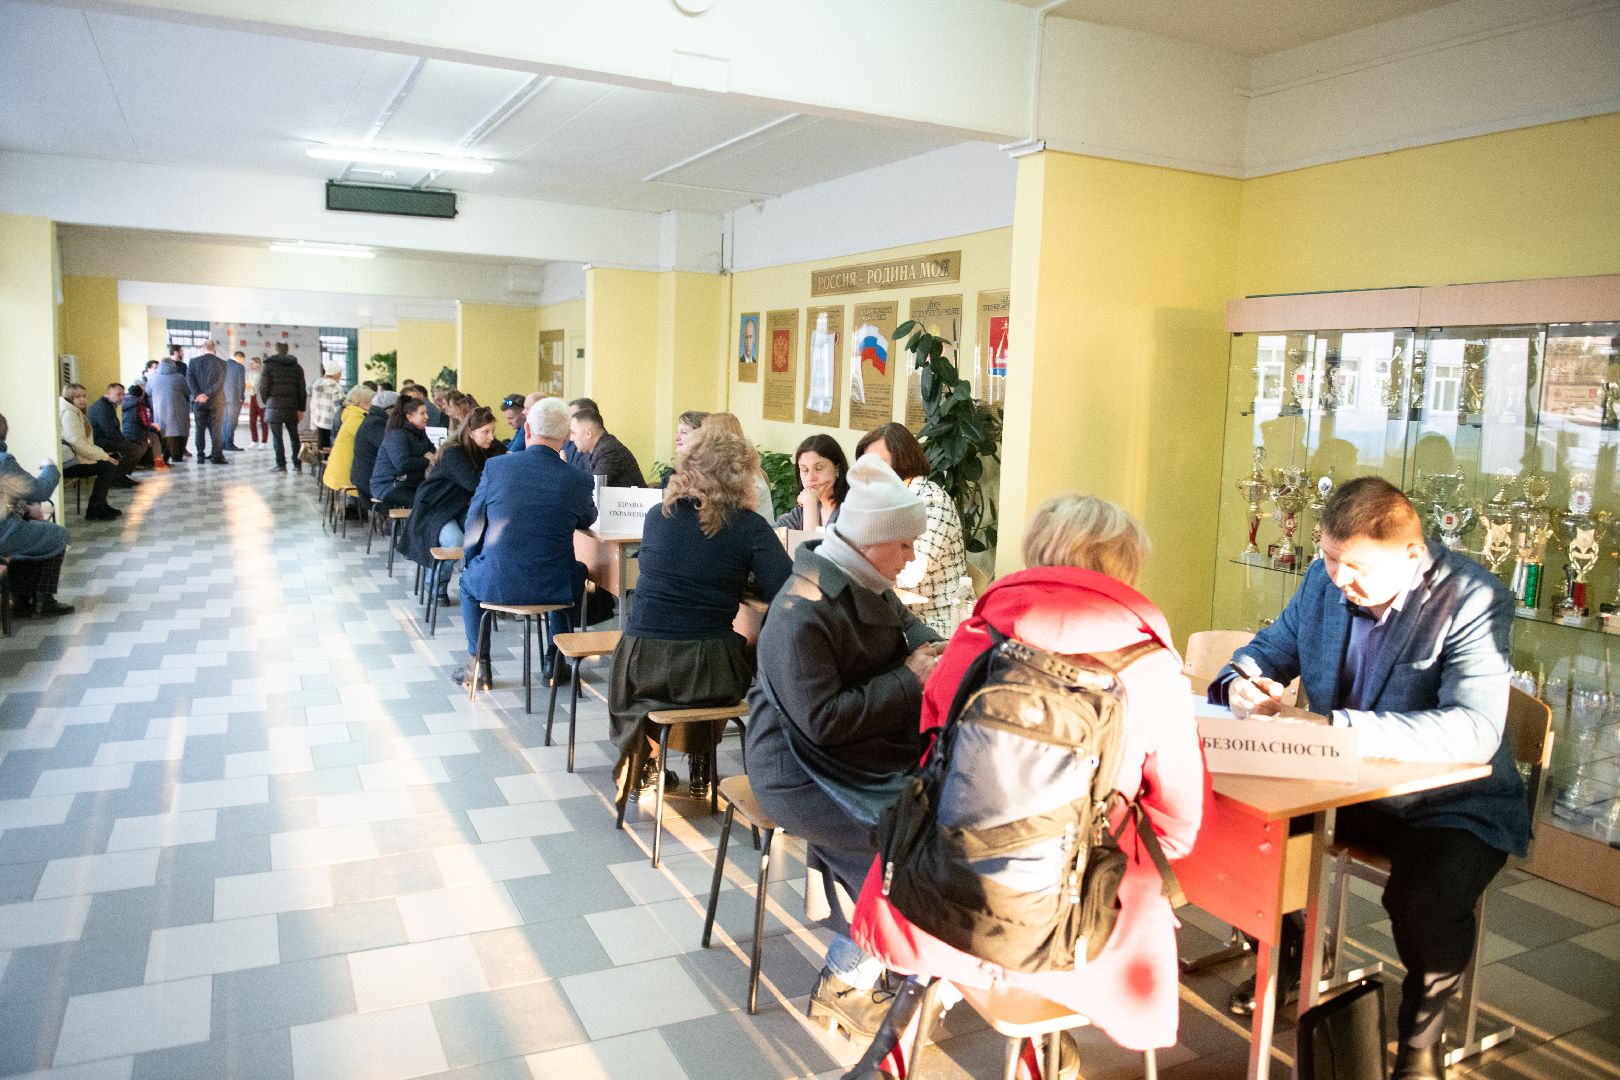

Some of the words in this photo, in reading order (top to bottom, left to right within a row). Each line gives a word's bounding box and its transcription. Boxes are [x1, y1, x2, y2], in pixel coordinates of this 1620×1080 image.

[817, 271, 857, 291] РОССИЯ
[866, 263, 916, 285] РОДИНА
[919, 258, 951, 279] МОЯ
[1203, 736, 1340, 758] БЕЗОПАСНОСТЬ
